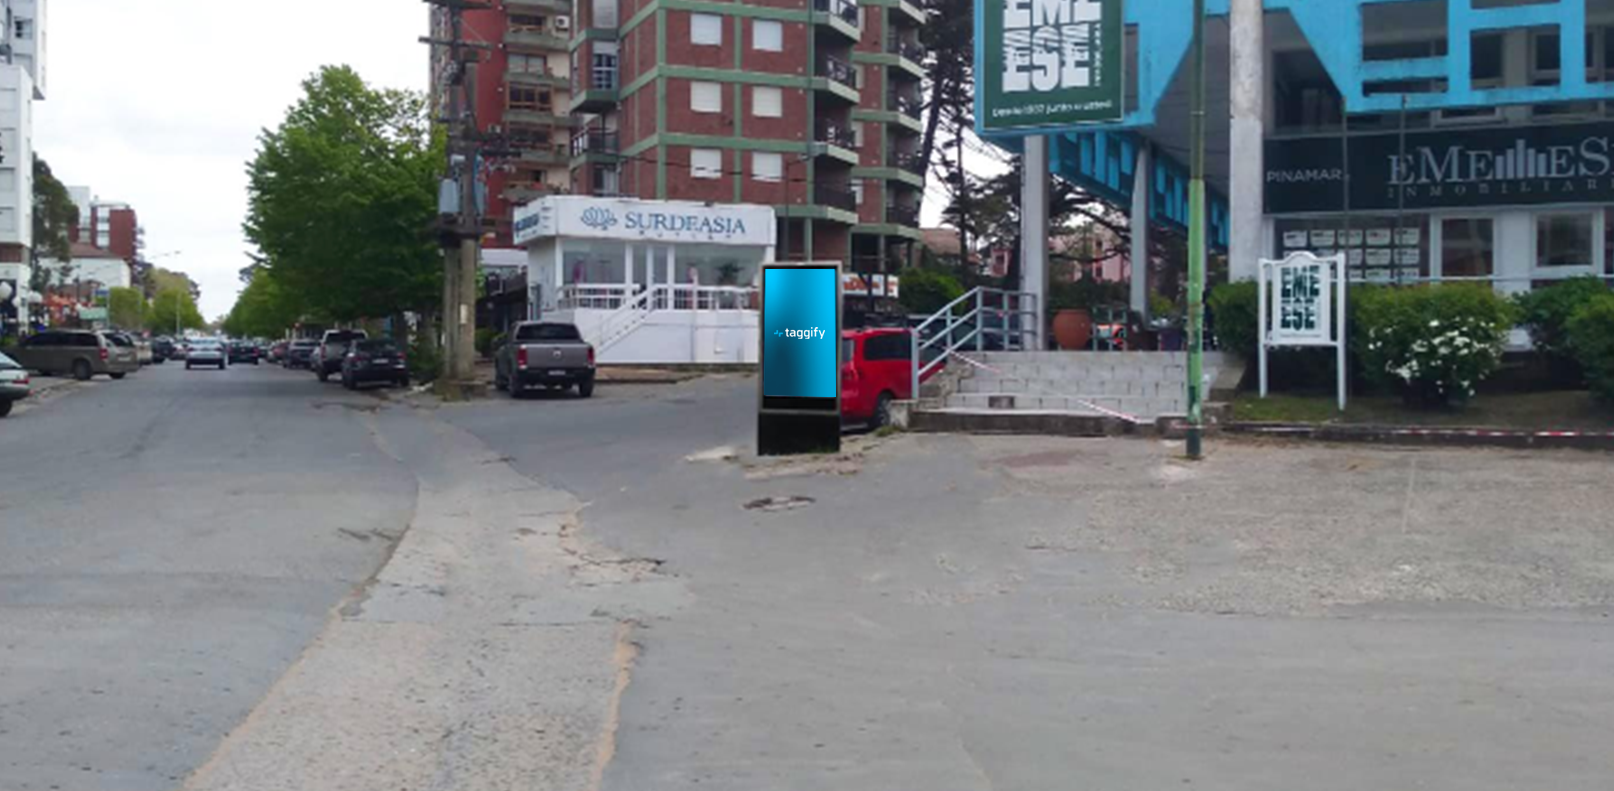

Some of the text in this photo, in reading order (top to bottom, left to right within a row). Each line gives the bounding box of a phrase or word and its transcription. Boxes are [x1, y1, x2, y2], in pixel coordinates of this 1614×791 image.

[1002, 24, 1090, 93] ESE
[624, 211, 747, 234] SURDEASIA
[1281, 265, 1320, 298] EME
[1280, 298, 1316, 331] ESE
[784, 326, 826, 340] taggify
